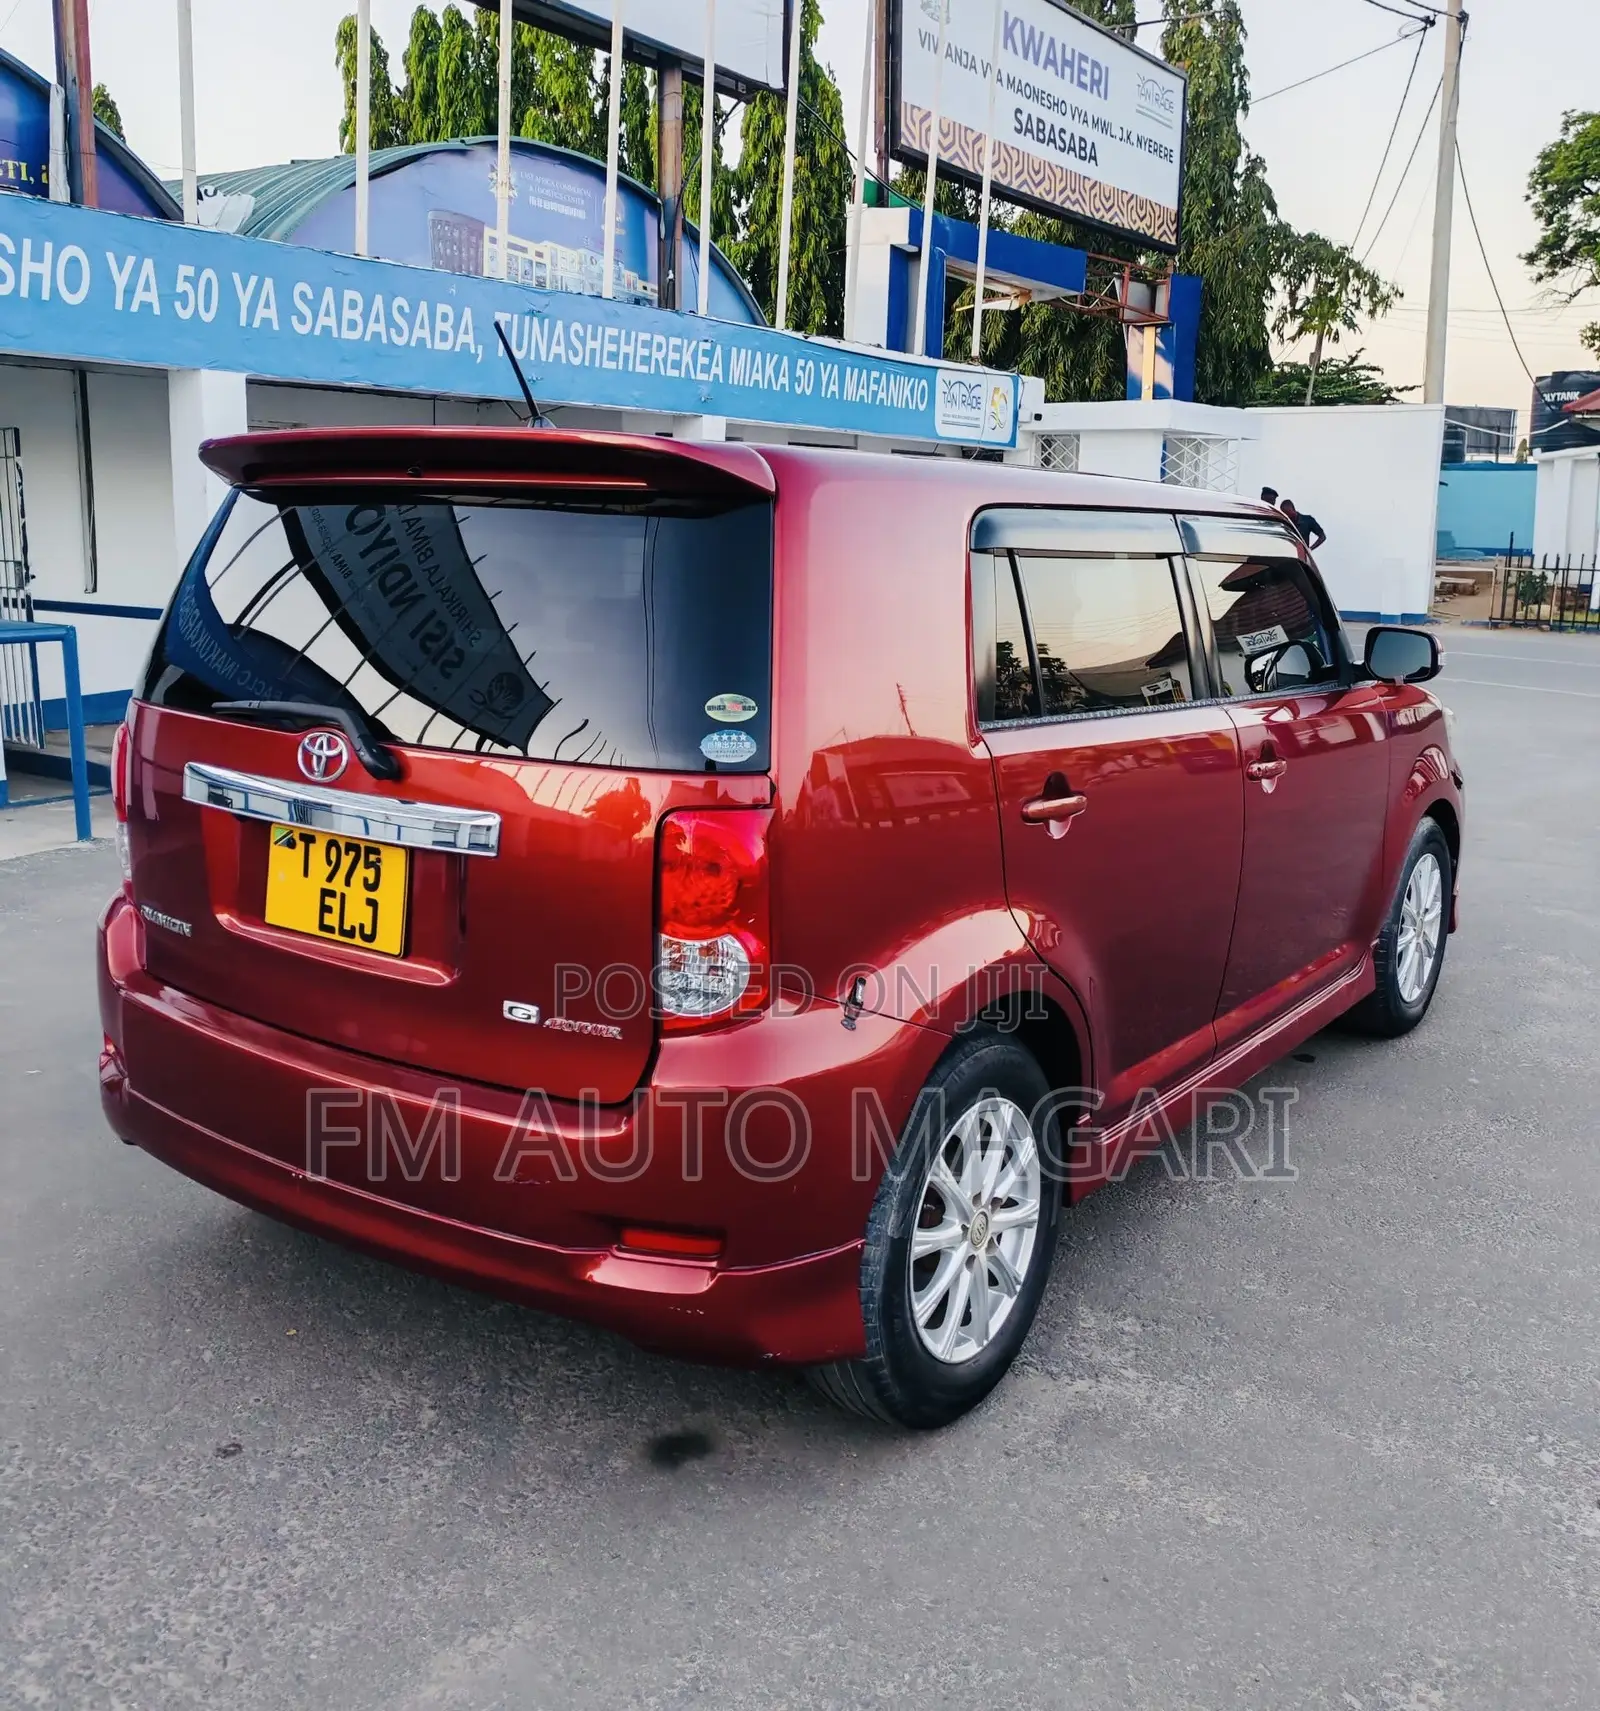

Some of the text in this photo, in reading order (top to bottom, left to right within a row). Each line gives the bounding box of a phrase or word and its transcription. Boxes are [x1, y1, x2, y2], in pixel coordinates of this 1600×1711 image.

[1003, 10, 1109, 101] KWAHERI
[1006, 73, 1068, 117] MAONESHO
[1070, 104, 1089, 127] VYA
[1092, 117, 1117, 140] MWL.
[1119, 125, 1135, 148] J.K.
[1136, 132, 1174, 165] NYERERE
[1013, 107, 1099, 167] SABASABA
[0, 159, 42, 192] TI,
[106, 252, 161, 316] YA
[174, 264, 219, 323] 50
[232, 272, 280, 331] YA
[291, 281, 483, 363] SABASABA,
[494, 311, 724, 384] TUNASHEHEREKEA
[729, 347, 790, 393] MIAKA
[794, 358, 814, 396] 50
[820, 362, 840, 400] YA
[843, 367, 929, 412] MAFANIKIO
[298, 832, 382, 892] T 975
[318, 887, 379, 944] ELJ
[506, 1003, 534, 1022] G
